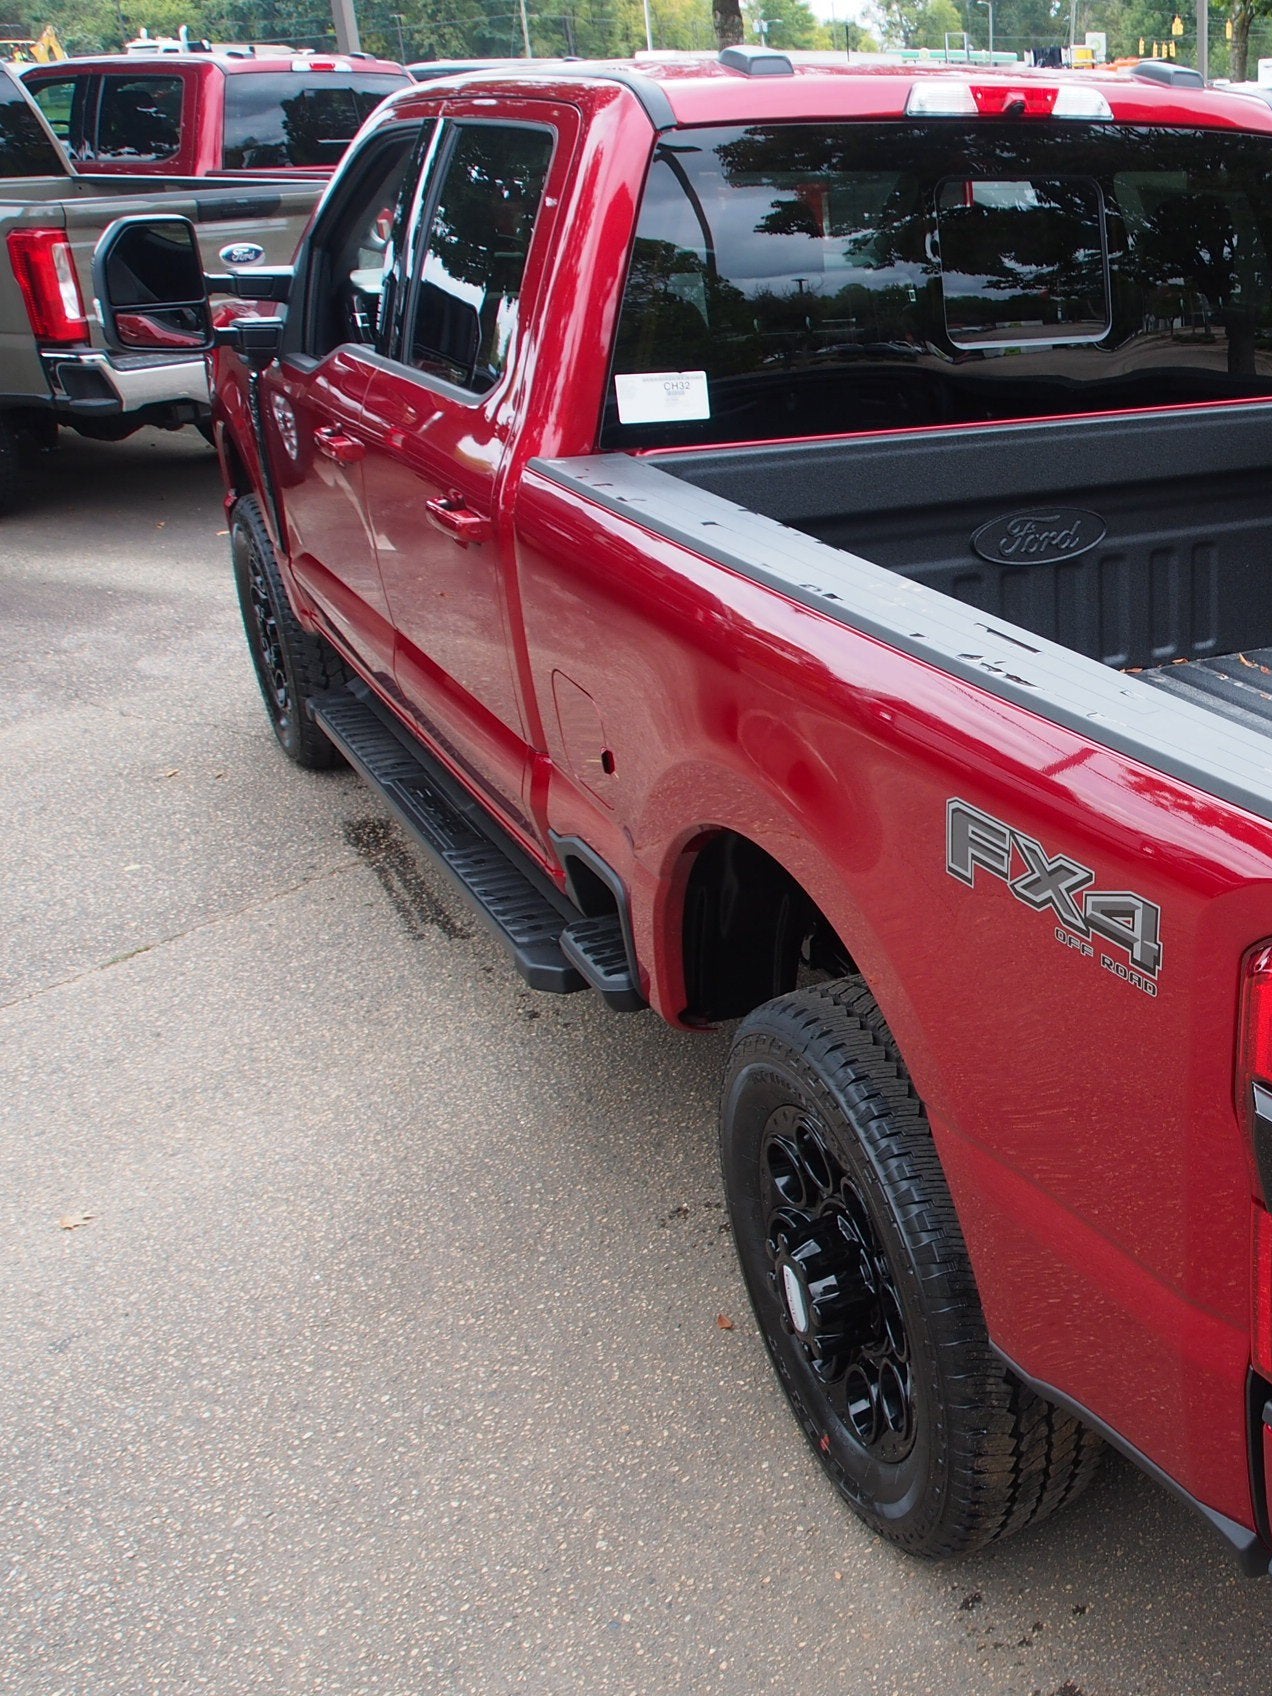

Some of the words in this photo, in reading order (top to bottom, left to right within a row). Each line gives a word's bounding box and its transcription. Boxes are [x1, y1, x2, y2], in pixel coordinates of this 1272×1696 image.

[231, 248, 256, 262] Ford
[663, 381, 691, 391] CH32
[999, 515, 1082, 557] Ford
[946, 796, 1164, 981] FX4
[1054, 926, 1094, 958] OFF
[1100, 953, 1158, 998] ROAD
